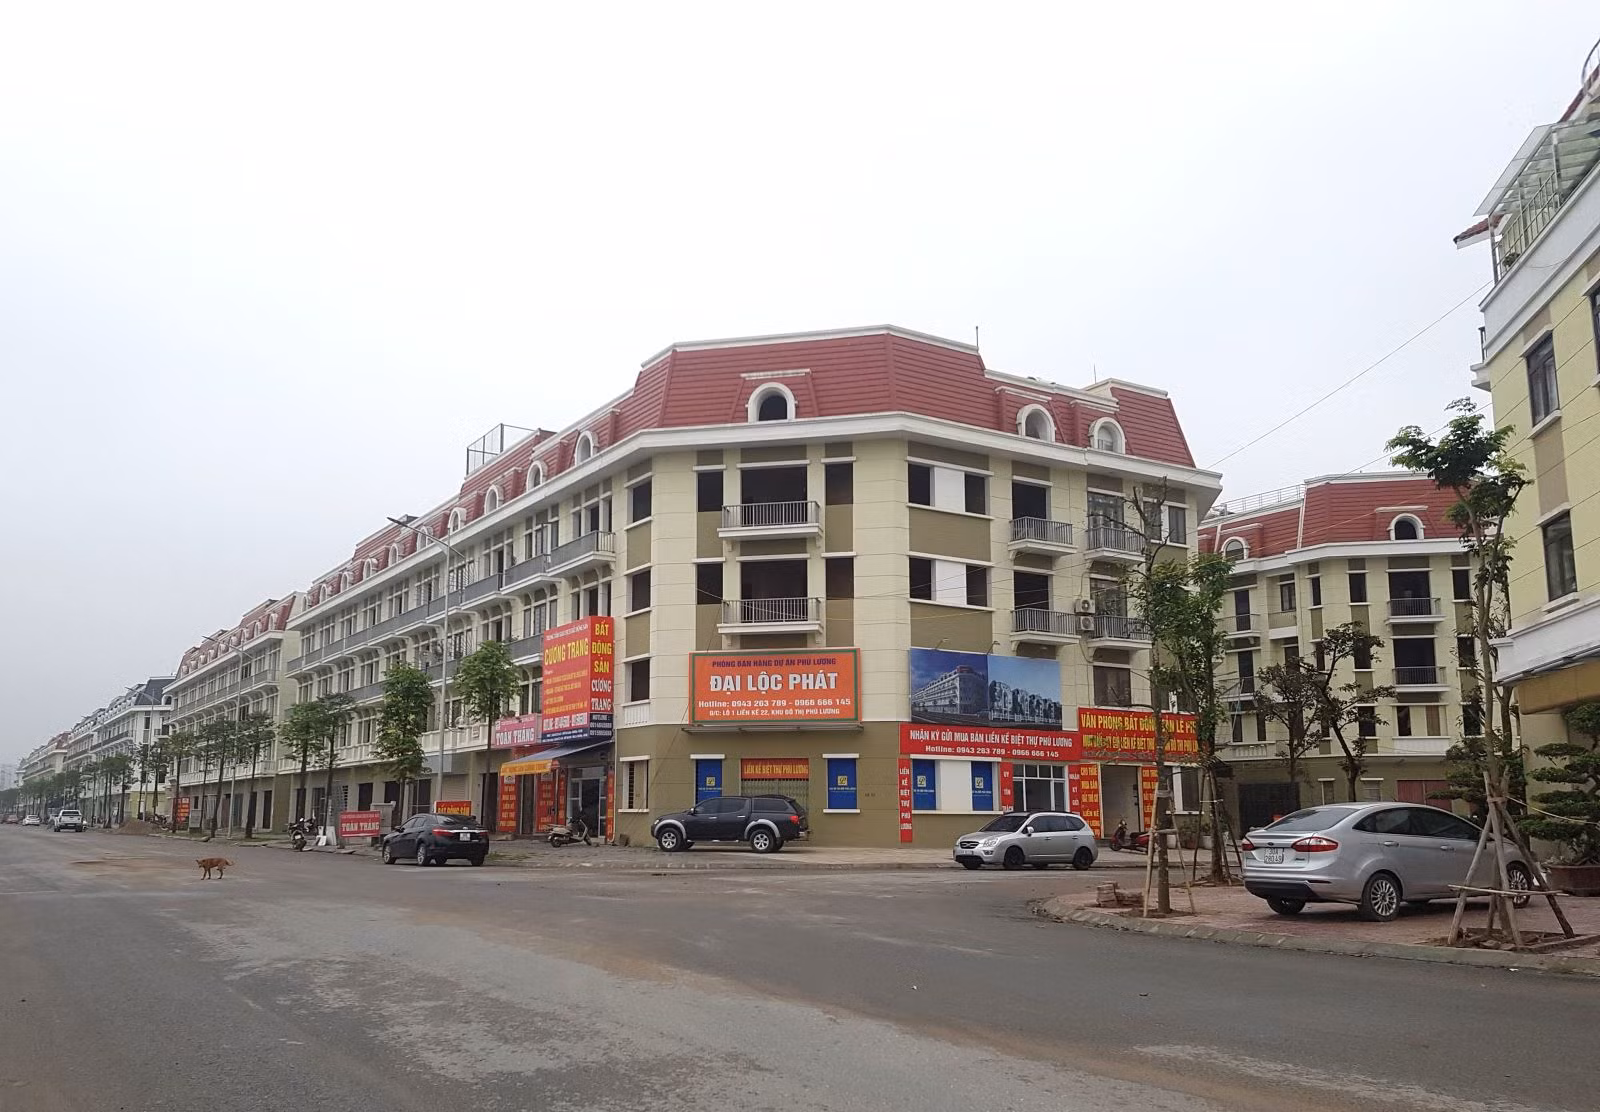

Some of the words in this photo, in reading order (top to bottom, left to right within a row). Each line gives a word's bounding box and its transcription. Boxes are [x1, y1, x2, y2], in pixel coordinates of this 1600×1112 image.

[595, 619, 609, 636] BẤT
[568, 638, 589, 660] TRANG
[591, 639, 612, 657] ĐỘNG
[594, 656, 610, 673] SẢN
[709, 674, 741, 695] ĐẠI
[747, 671, 783, 695] LỘC
[788, 669, 838, 690] PHÁT
[591, 697, 612, 711] TRANG
[698, 700, 730, 708] Hotline:
[1081, 711, 1097, 729] VĂN
[1125, 712, 1138, 732] BẤT
[910, 728, 930, 742] NHẬN
[954, 731, 969, 743] MUA
[970, 730, 984, 744] BÁN
[925, 745, 955, 753] Hotline:
